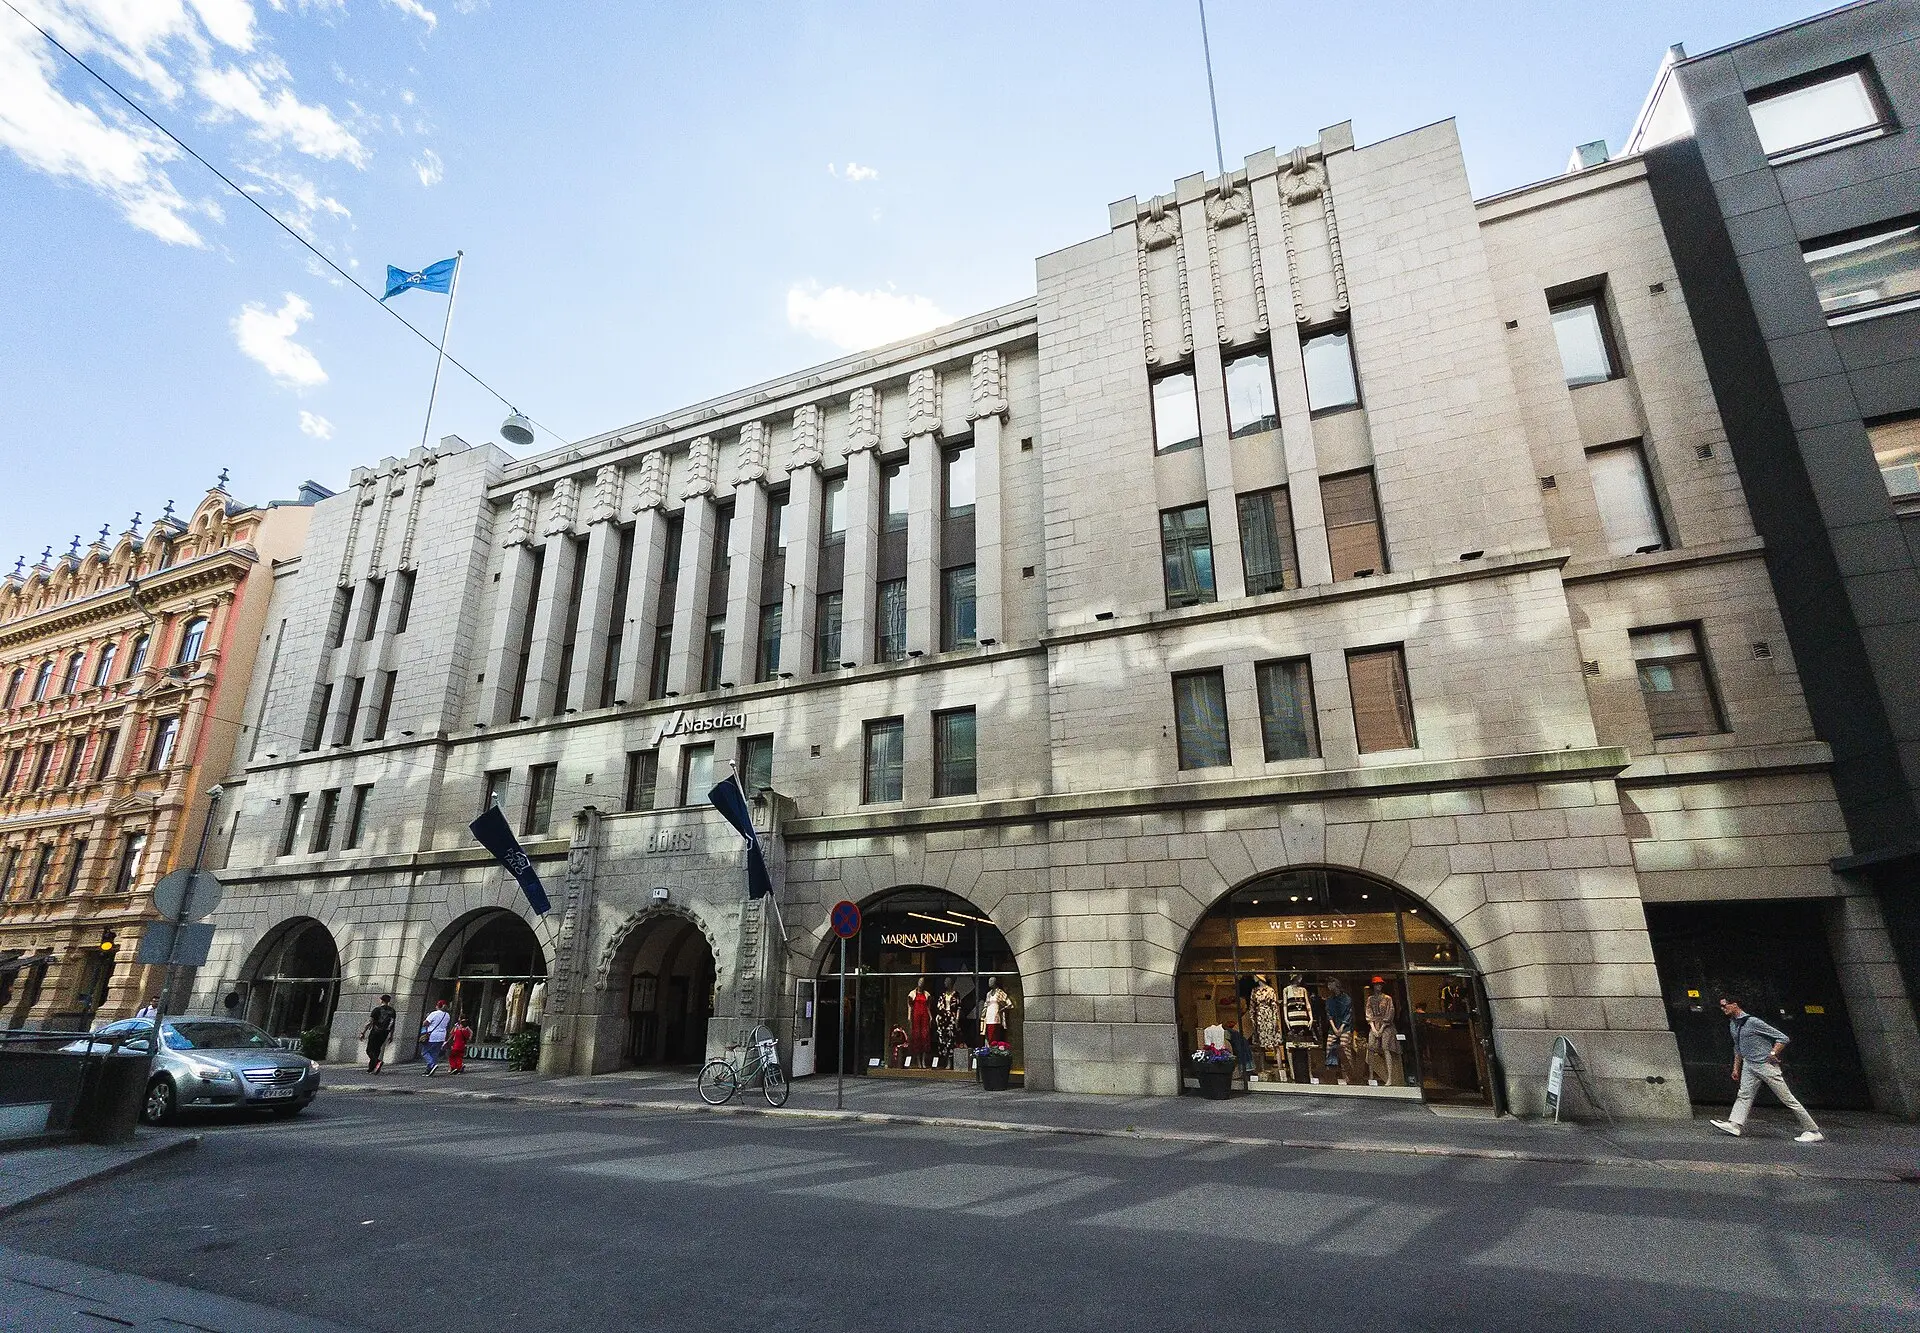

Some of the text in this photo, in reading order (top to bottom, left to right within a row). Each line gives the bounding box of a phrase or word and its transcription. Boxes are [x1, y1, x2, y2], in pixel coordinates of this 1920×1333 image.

[681, 711, 746, 732] Nasdaq
[646, 829, 692, 853] BÖRS
[1269, 919, 1356, 929] WEEKEND
[881, 932, 957, 946] MARINA RINALDI
